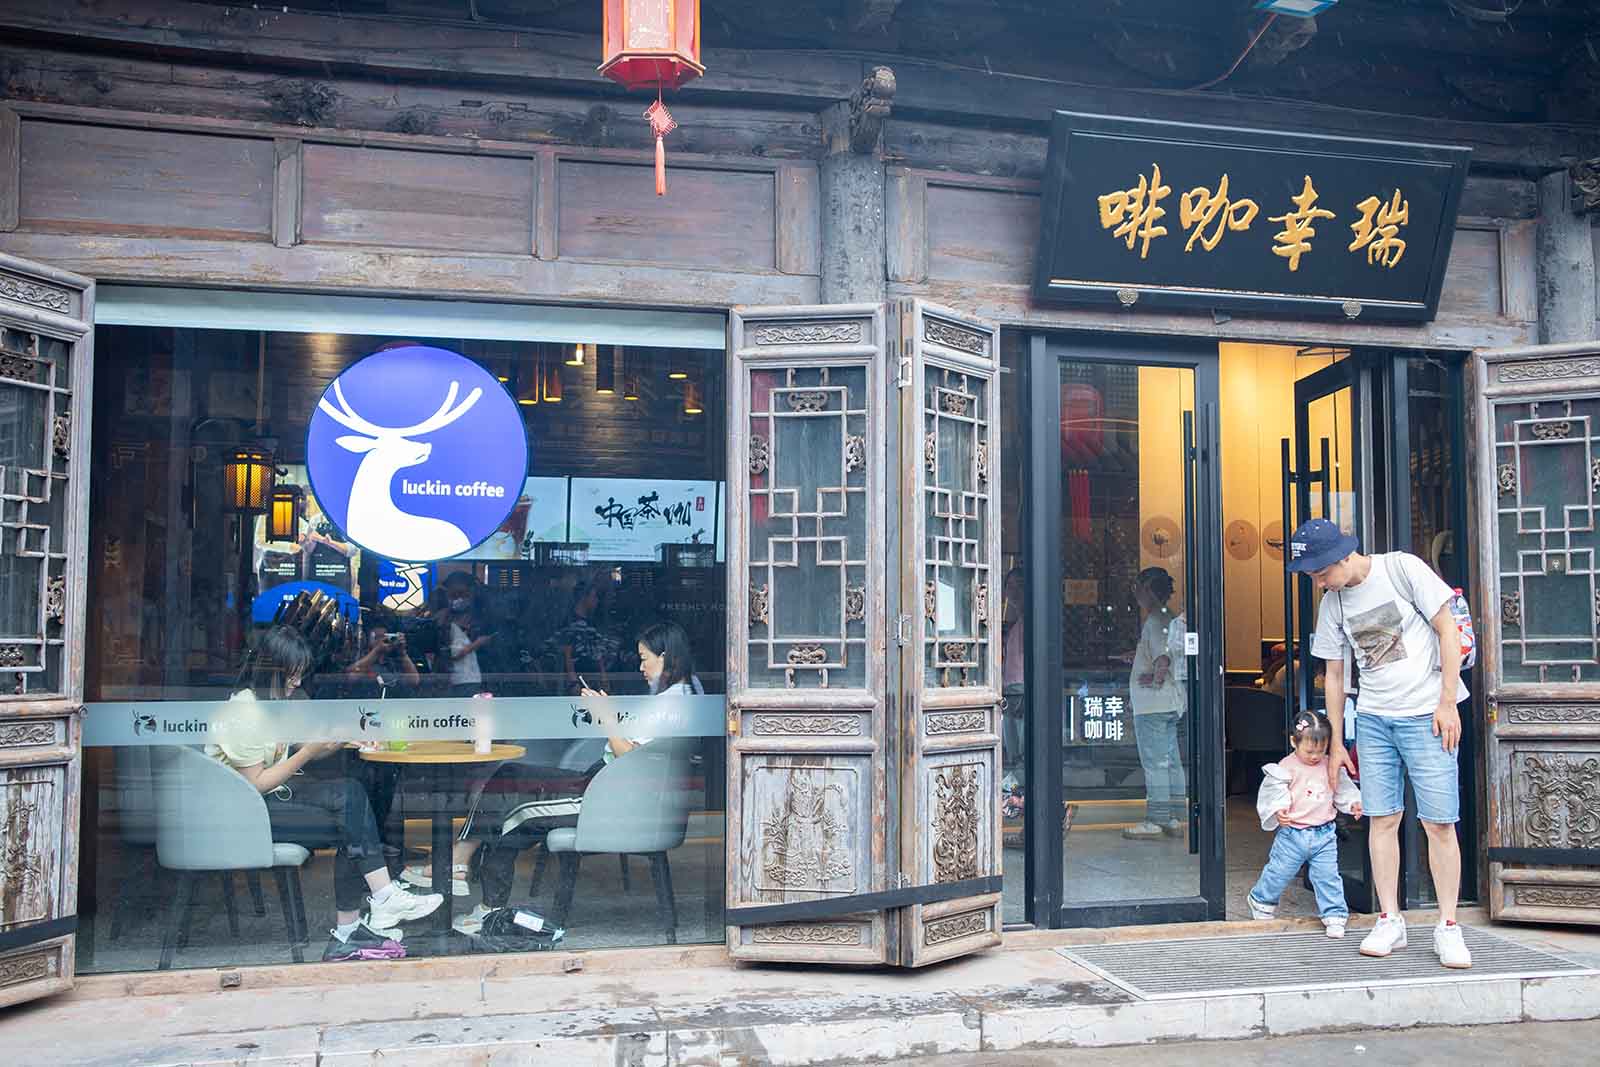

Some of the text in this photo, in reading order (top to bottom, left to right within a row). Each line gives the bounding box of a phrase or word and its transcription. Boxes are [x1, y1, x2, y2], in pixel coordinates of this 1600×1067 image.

[402, 479, 505, 498] luckin coffee
[1084, 696, 1124, 717] 瑞幸
[163, 718, 208, 732] luckin
[433, 714, 477, 728] coffee
[1084, 719, 1124, 741] 咖啡
